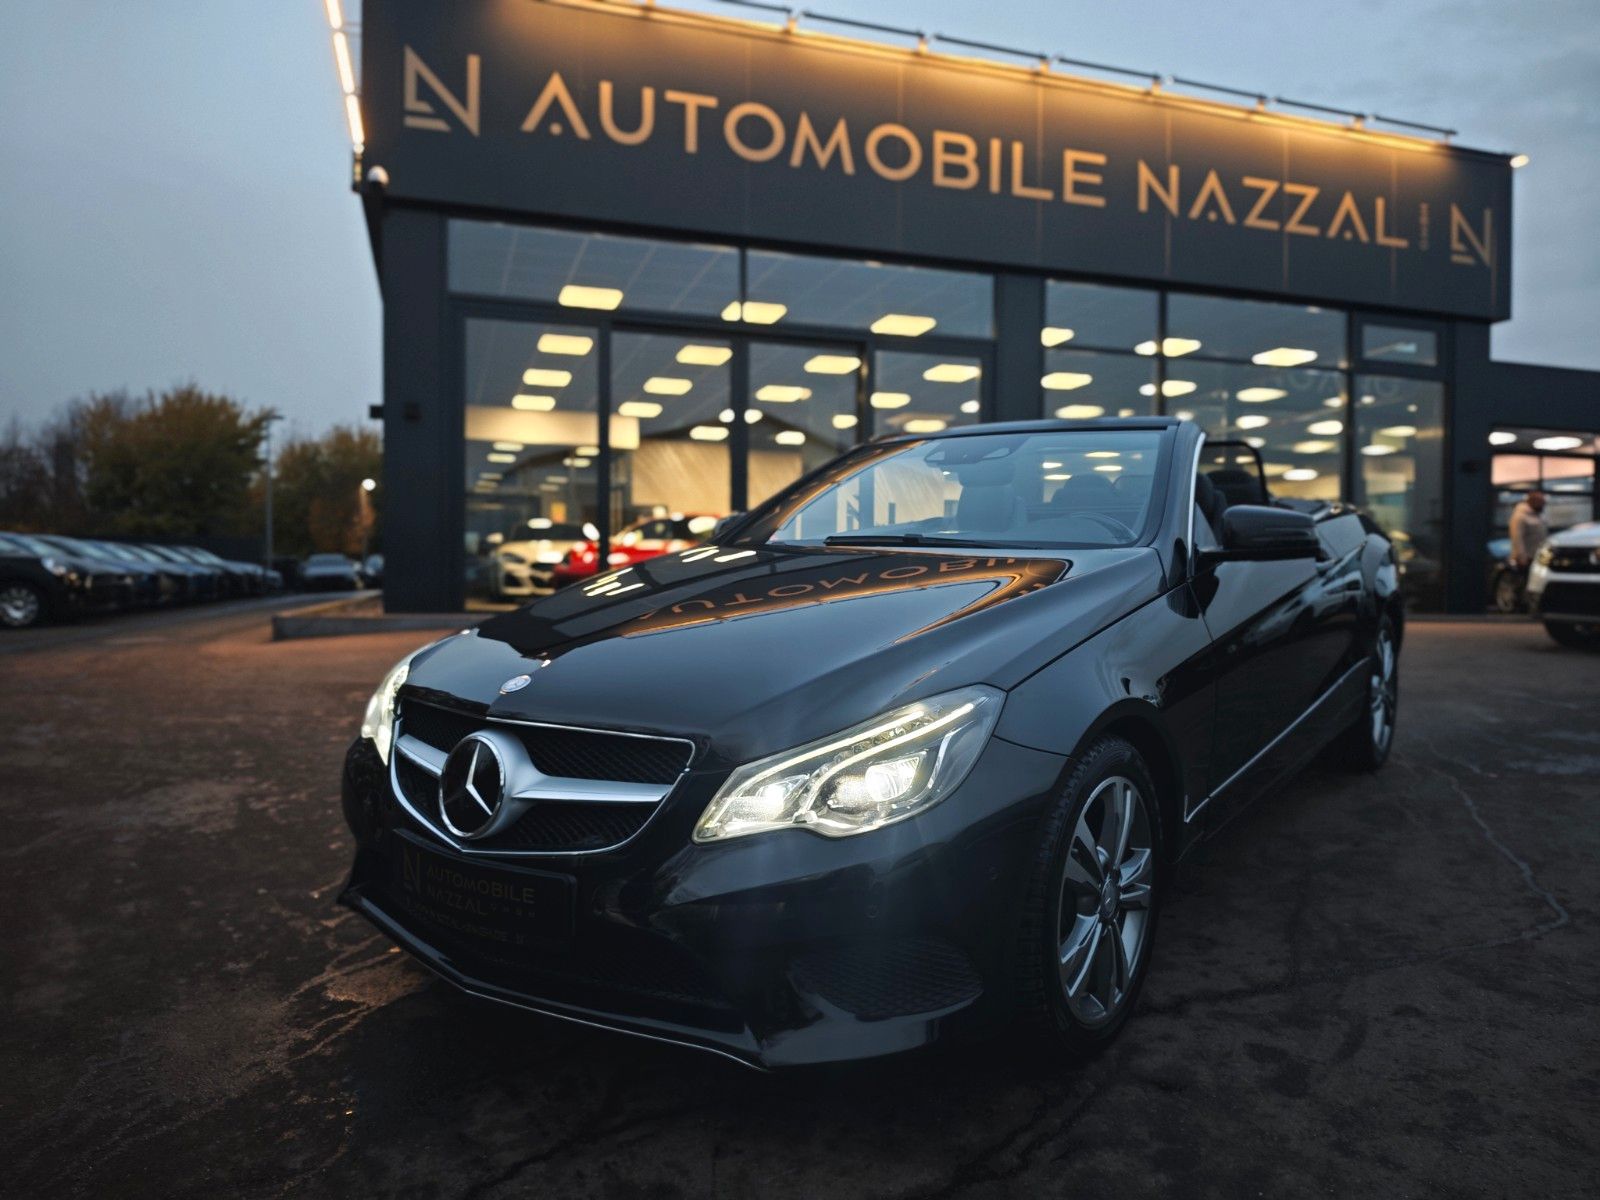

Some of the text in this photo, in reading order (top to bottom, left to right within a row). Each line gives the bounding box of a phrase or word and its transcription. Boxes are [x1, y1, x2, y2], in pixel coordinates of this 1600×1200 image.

[521, 72, 1107, 208] AUTOMOBILE
[1137, 159, 1409, 249] NAZZAL
[426, 865, 535, 904] AUTOMOBILE
